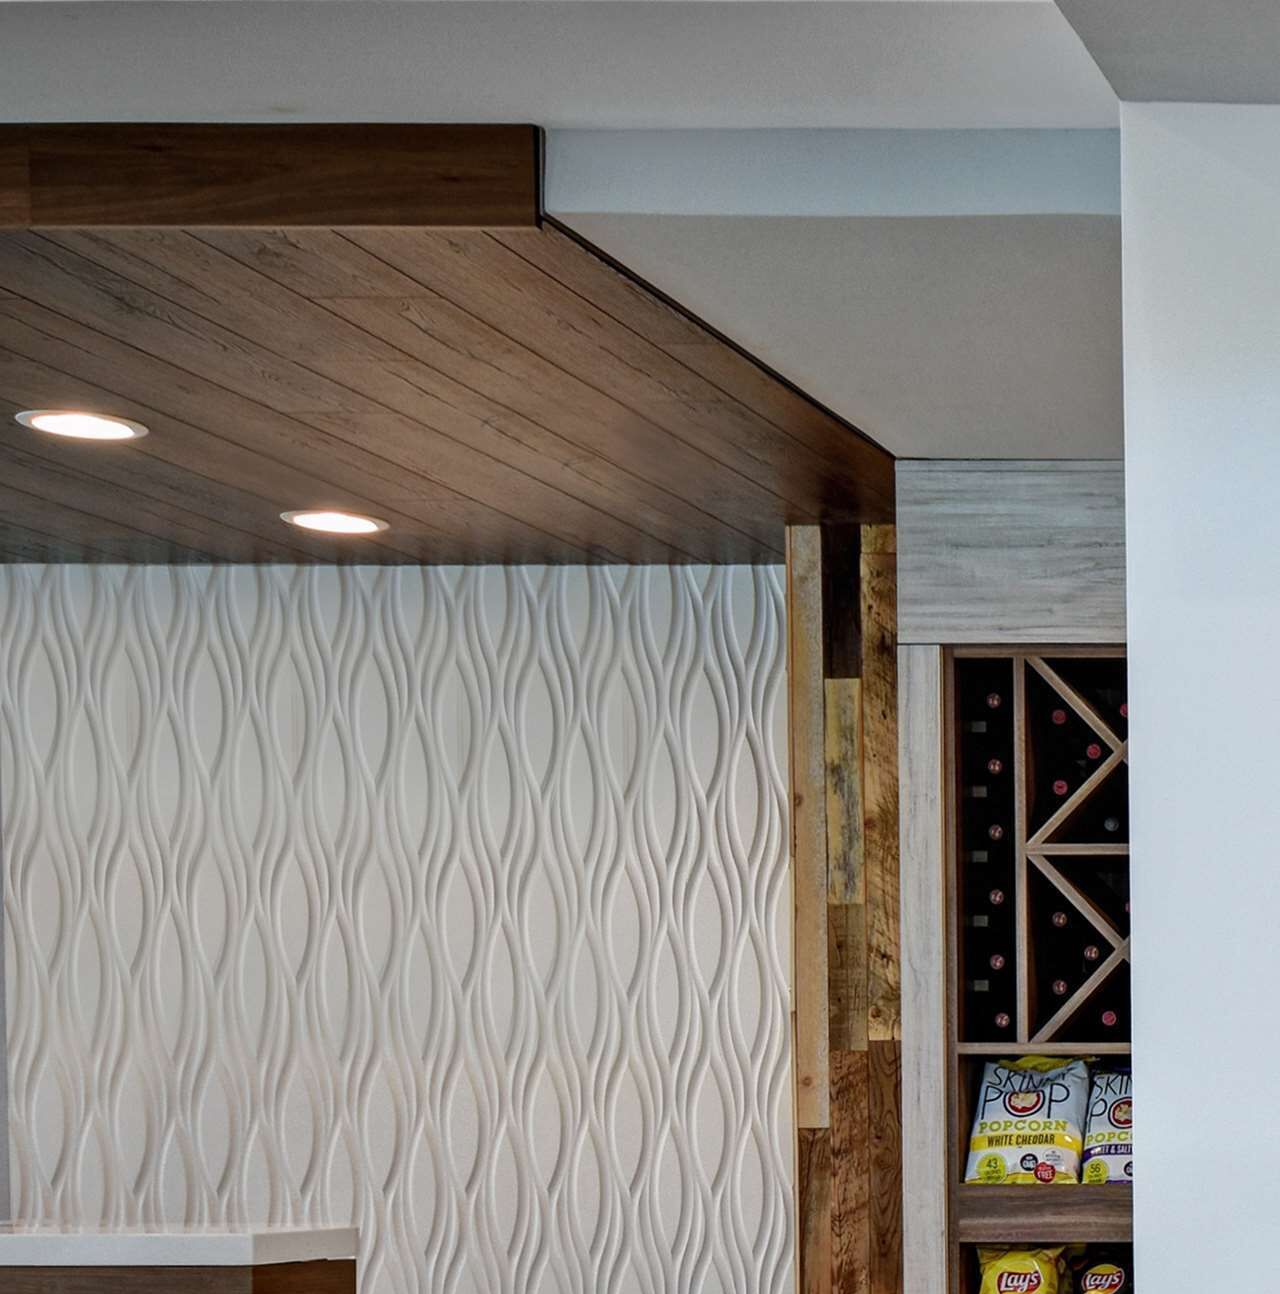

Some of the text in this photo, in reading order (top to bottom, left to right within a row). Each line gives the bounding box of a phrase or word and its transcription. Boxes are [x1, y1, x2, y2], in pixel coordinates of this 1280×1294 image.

[981, 1082, 1070, 1120] POP
[978, 1120, 1068, 1134] POPCORN
[987, 1134, 1055, 1147] WHITE CHEDDAR
[986, 1159, 998, 1169] 43
[1090, 1164, 1101, 1173] 56
[1001, 1272, 1039, 1292] Lay's
[1086, 1272, 1121, 1290] Lay's
